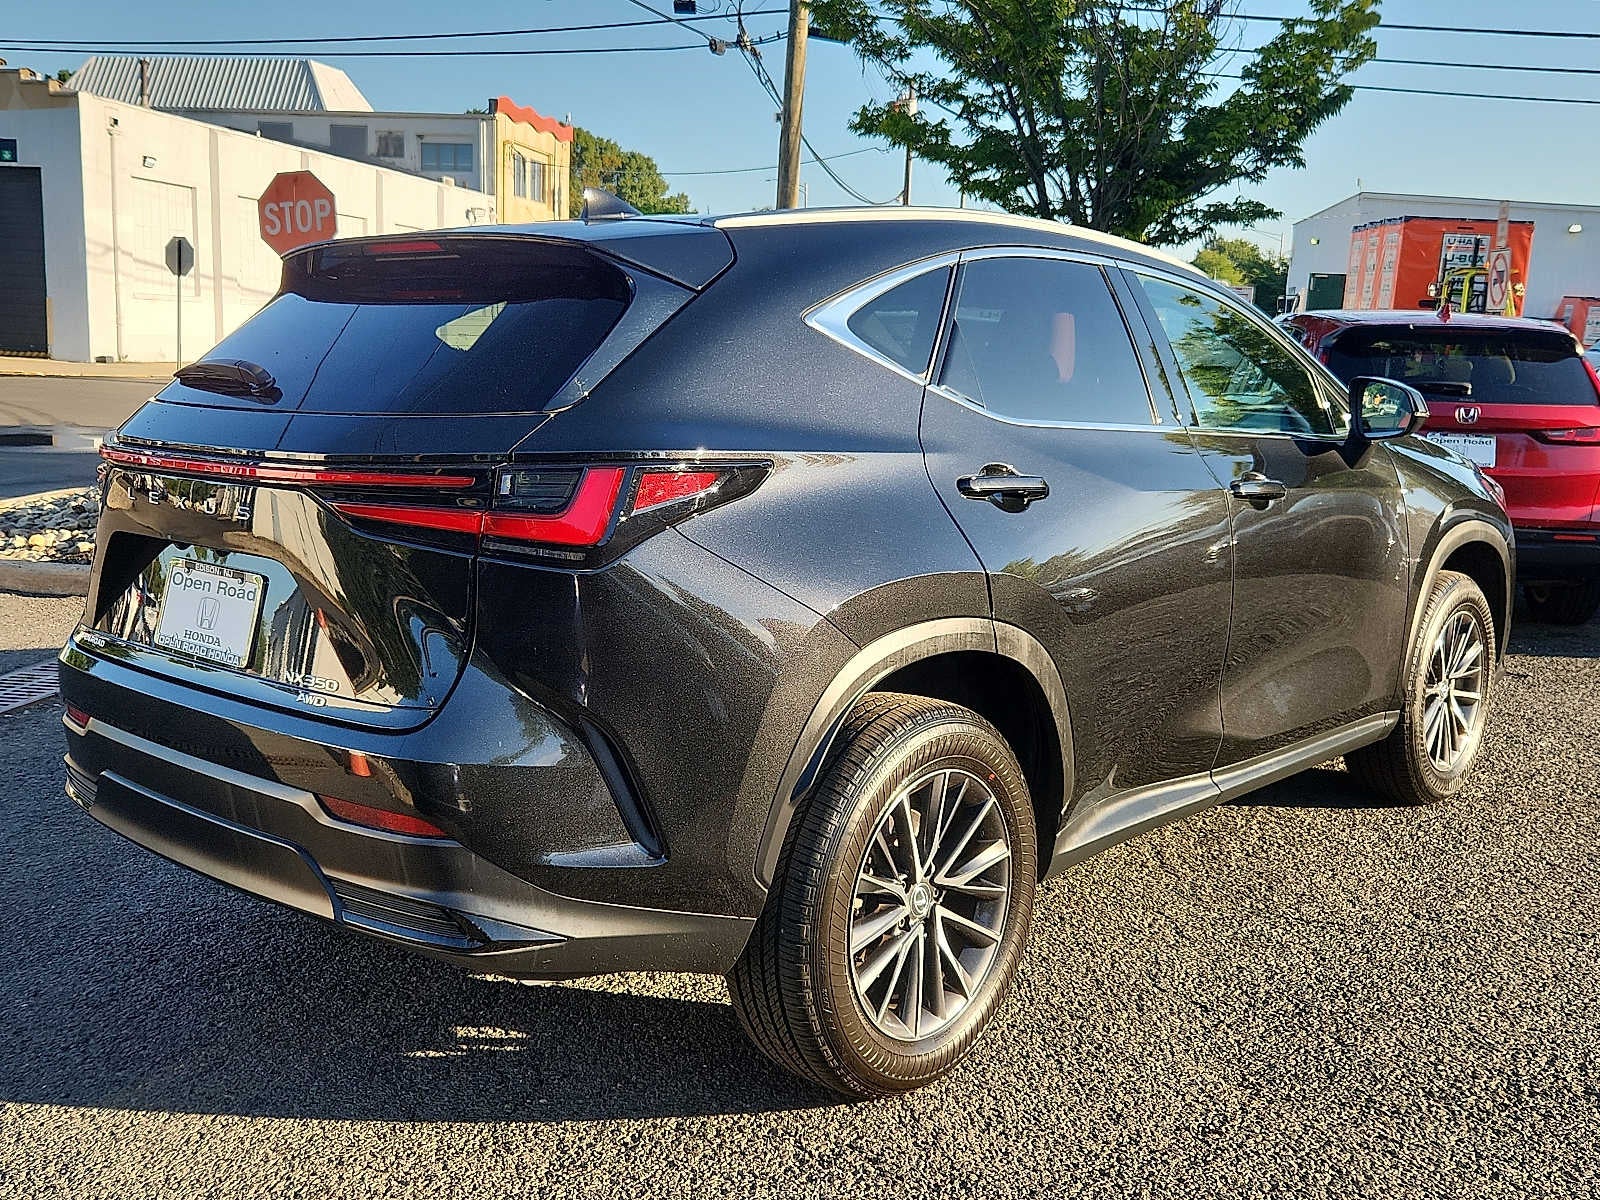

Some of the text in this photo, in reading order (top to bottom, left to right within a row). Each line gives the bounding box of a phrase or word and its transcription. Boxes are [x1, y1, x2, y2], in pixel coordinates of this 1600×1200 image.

[264, 199, 331, 236] STOP
[1447, 237, 1485, 246] U-HAL
[1430, 437, 1492, 446] Open Road
[127, 486, 251, 520] LEXUS
[172, 571, 257, 601] Open Road
[183, 629, 222, 647] HONDA
[158, 635, 240, 666] OPEN ROAD HONDA
[284, 671, 339, 692] NX350
[296, 691, 327, 707] AWD
